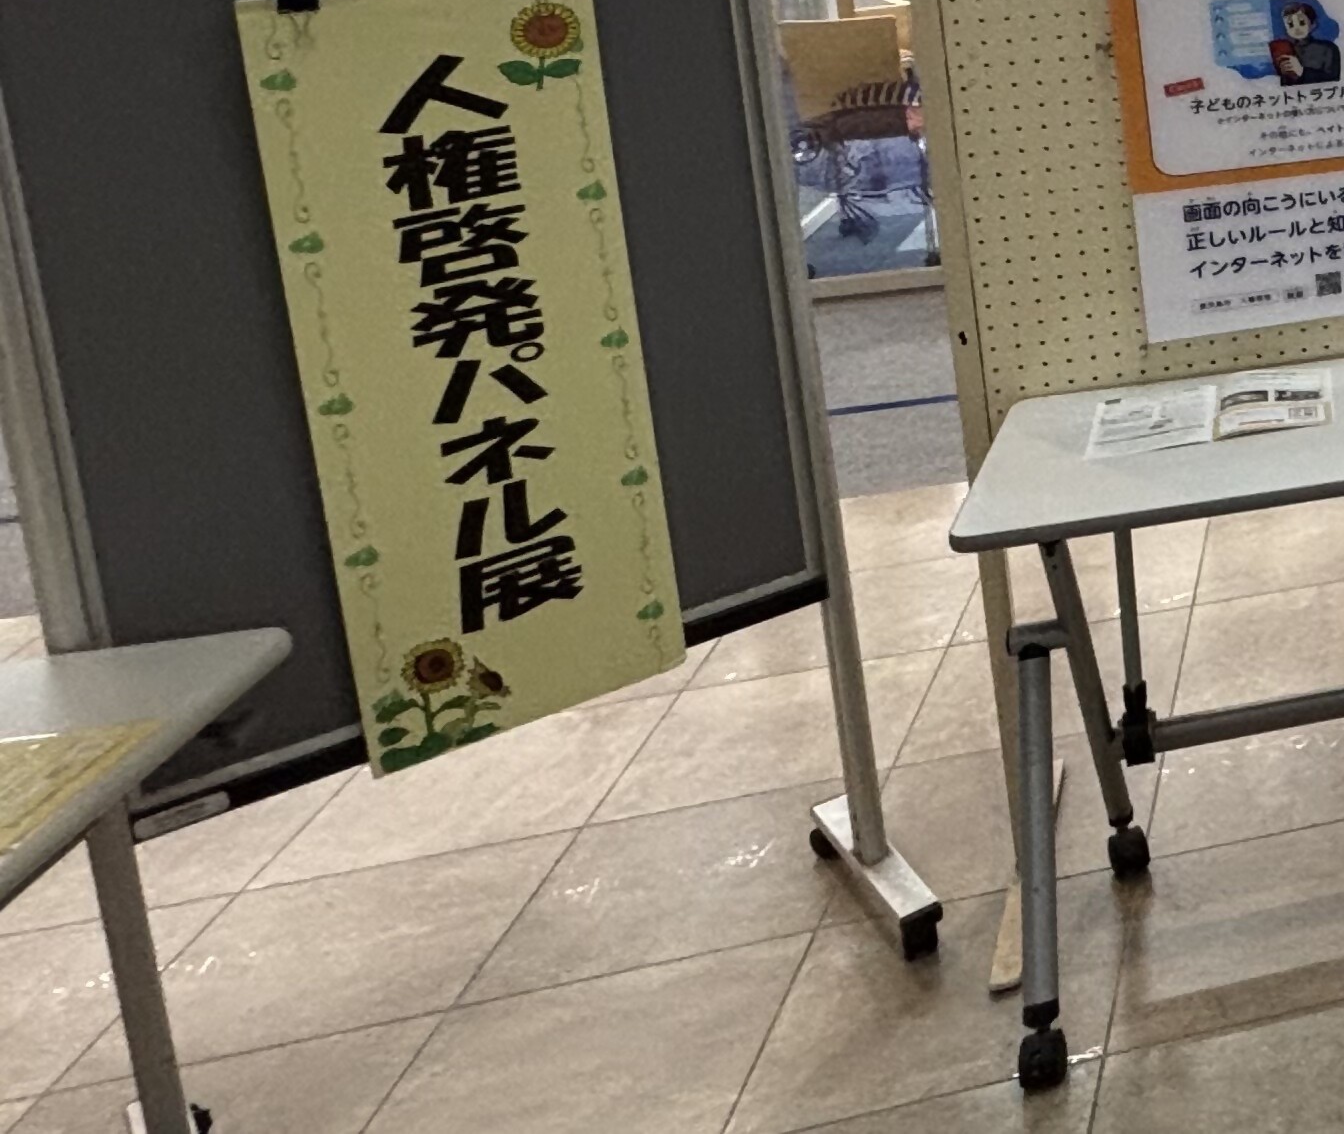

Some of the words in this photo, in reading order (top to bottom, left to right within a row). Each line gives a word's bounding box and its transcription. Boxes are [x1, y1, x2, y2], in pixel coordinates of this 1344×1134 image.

[377, 53, 584, 635] 人権啓発パネル展
